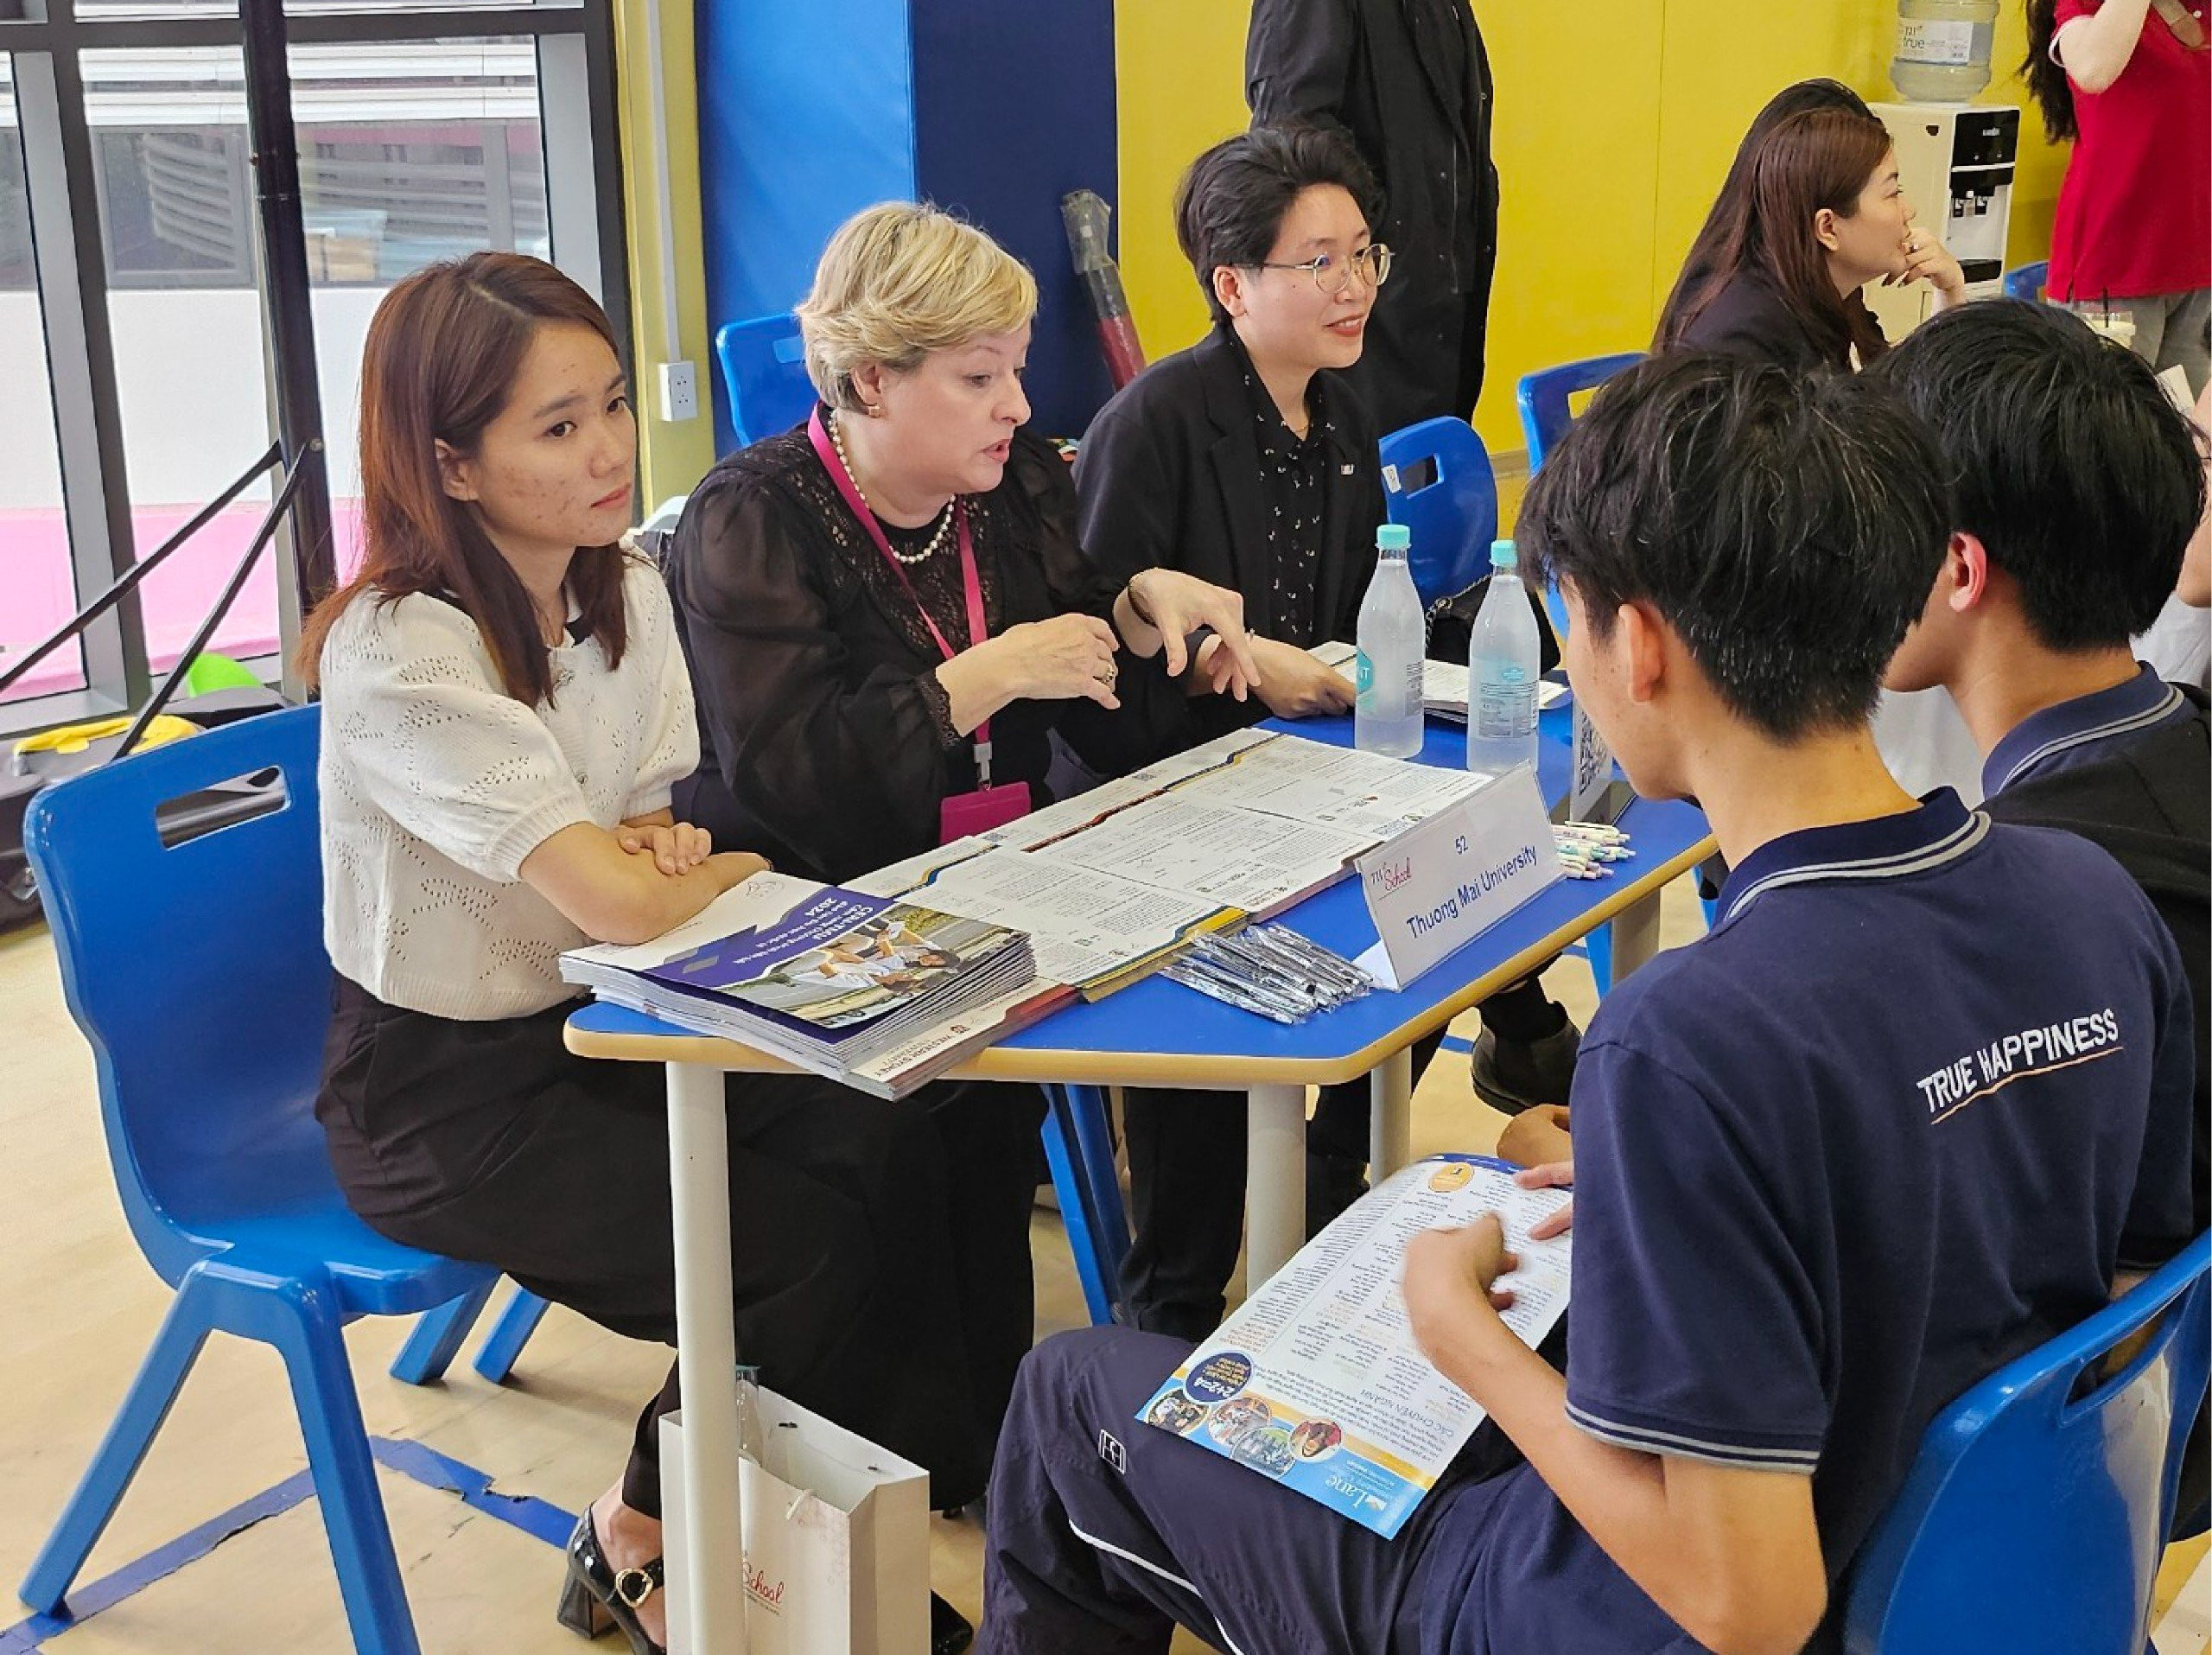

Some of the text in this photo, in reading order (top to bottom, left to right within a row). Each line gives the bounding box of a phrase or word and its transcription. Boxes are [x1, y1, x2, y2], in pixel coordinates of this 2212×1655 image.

[1455, 836, 1468, 856] 52
[1383, 856, 1412, 891] School
[1406, 843, 1537, 939] Thuong Mai University
[1916, 1008, 2119, 1113] TRUE HAPPINESS
[1325, 1474, 1367, 1509] Lane
[743, 1561, 785, 1604] School
